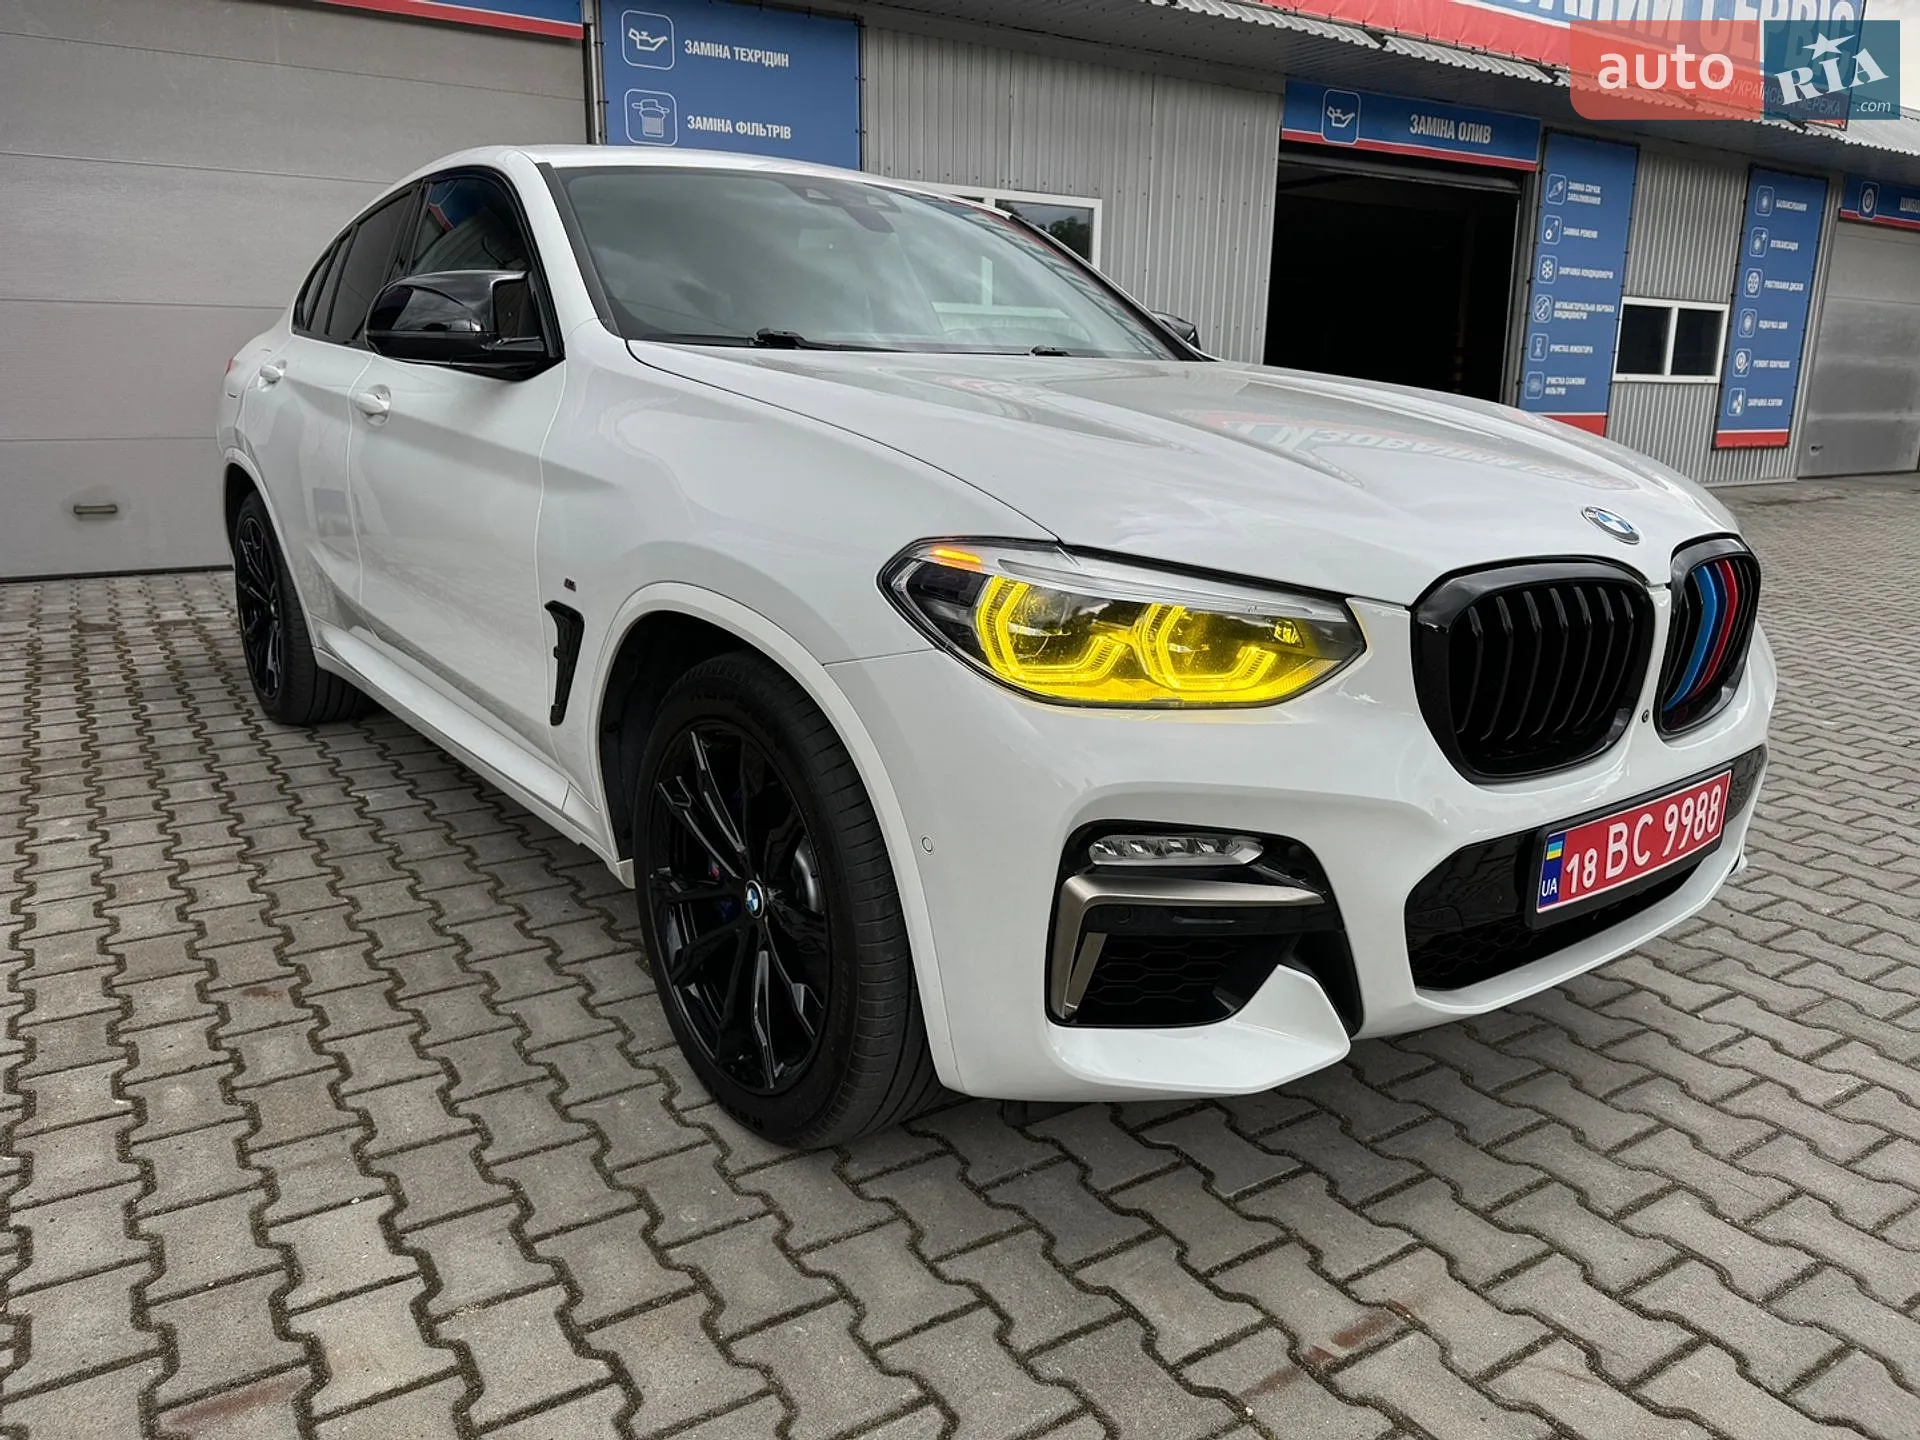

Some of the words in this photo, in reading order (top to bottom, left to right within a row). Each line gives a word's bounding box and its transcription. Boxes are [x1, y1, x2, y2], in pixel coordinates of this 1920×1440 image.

[684, 39, 731, 60] ЗАМІНА
[733, 46, 790, 68] ТЕХРІДИН
[687, 115, 733, 134] ЗАМІНА
[735, 120, 793, 140] ФІЛЬТРІВ
[1409, 114, 1455, 139] ЗАМІНА
[1458, 121, 1492, 145] ОЛИВ
[1565, 847, 1598, 894] 18
[1605, 813, 1654, 880] BC
[1662, 784, 1722, 858] 9988
[1541, 877, 1558, 897] UA
